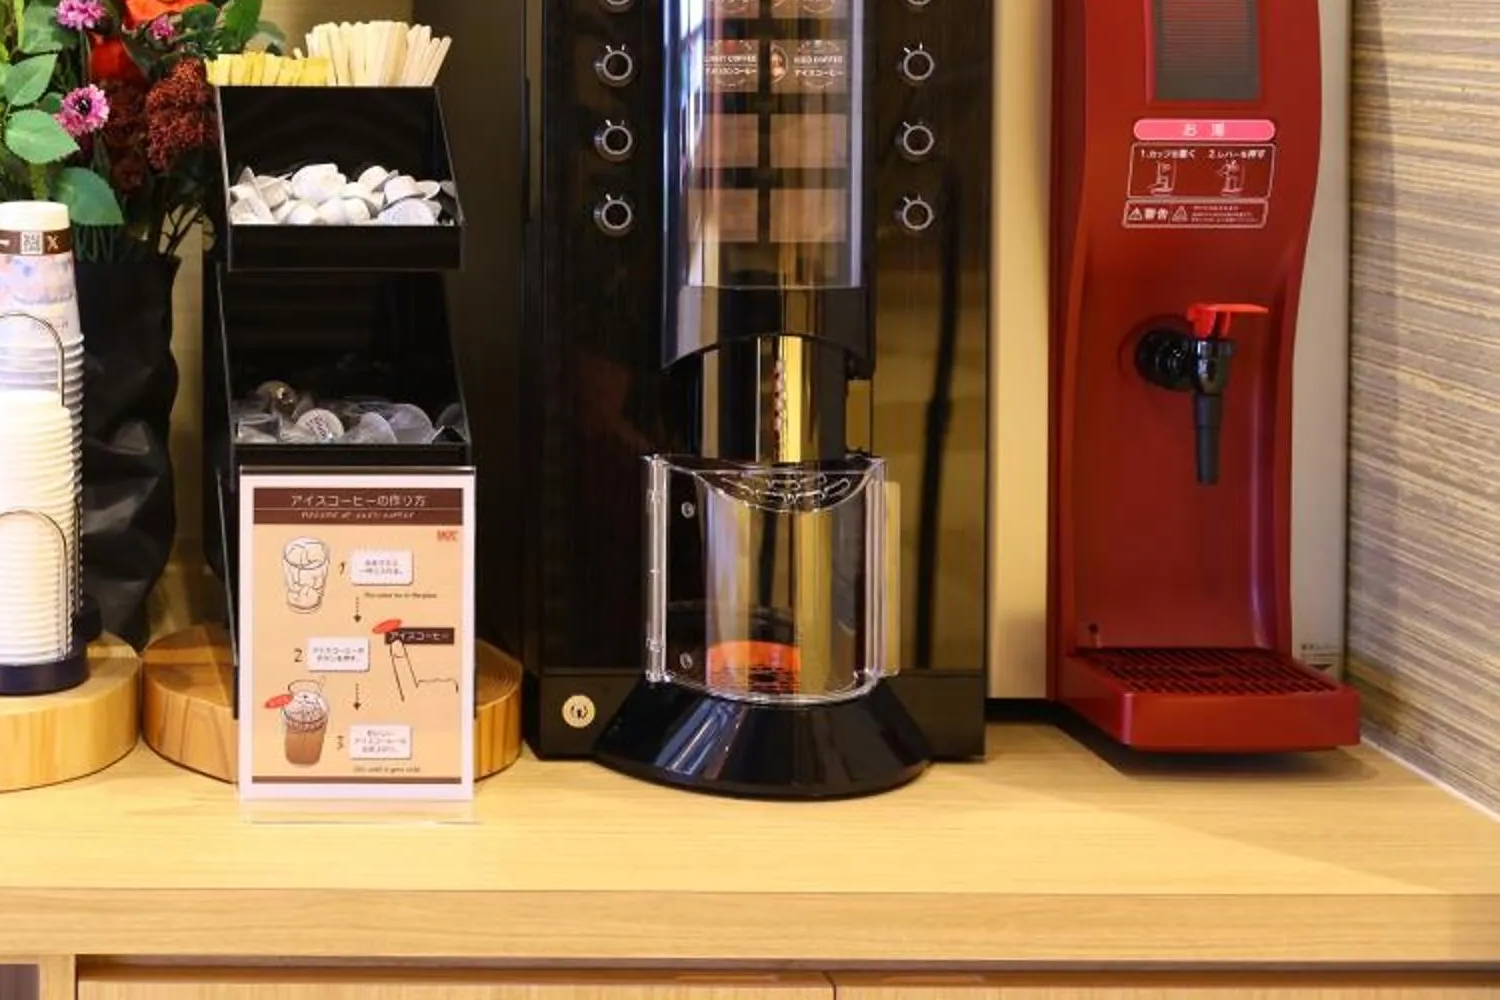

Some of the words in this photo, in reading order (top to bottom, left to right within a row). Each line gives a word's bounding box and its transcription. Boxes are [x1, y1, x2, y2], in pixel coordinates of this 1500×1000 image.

[291, 495, 426, 507] アイスコーヒーの作り方
[293, 648, 303, 663] 2
